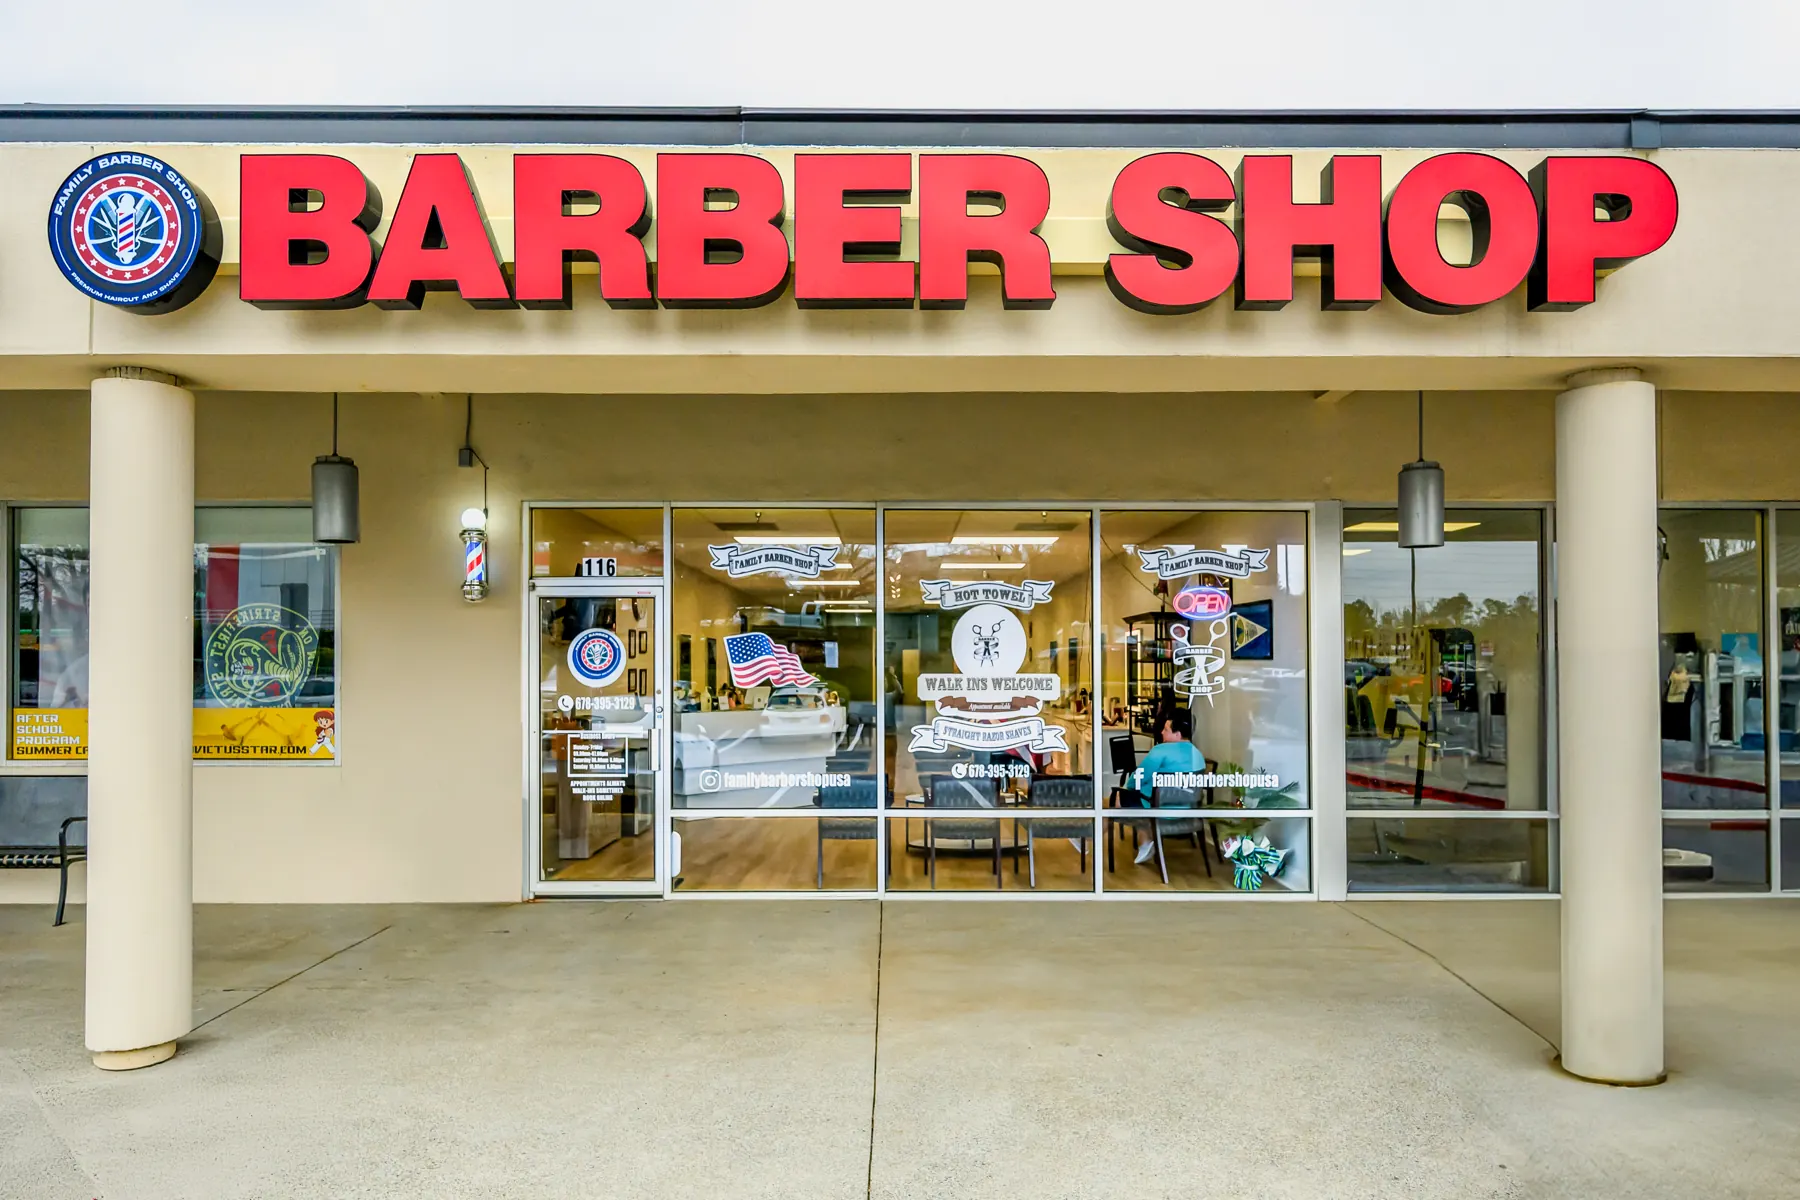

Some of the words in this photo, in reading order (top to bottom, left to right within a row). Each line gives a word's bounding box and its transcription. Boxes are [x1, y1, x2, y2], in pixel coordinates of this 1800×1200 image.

[54, 164, 93, 216] FAMILY
[98, 154, 164, 174] BARBER
[165, 170, 197, 211] SHOP
[240, 153, 1056, 309] BARBER
[1105, 152, 1678, 312] SHOP
[71, 271, 103, 298] PREMIUM
[104, 294, 139, 303] HAIRCUT
[142, 290, 158, 300] AND
[159, 272, 181, 292] SHAVE
[584, 558, 616, 576] 116
[734, 555, 763, 569] FAMILY
[764, 553, 793, 565] BARBER
[794, 558, 813, 569] SHOP
[1165, 558, 1192, 572] FAMILY
[1194, 557, 1223, 568] BARBER
[1225, 561, 1244, 572] SHOP
[954, 589, 979, 601] HOT
[982, 589, 1026, 602] TOWEL
[1173, 592, 1229, 614] OPEN
[925, 677, 963, 691] WALK
[967, 677, 988, 691] INS
[991, 677, 1053, 691] WELCOME
[575, 696, 635, 710] 678-395-3129
[16, 714, 58, 723] AFTER
[16, 725, 65, 734] SCHOOL
[942, 725, 981, 741] STRAIGHT
[982, 731, 1004, 742] RAZOR
[1005, 726, 1032, 739] SHAVES
[16, 736, 80, 745] PROGRAM
[17, 746, 72, 755] SUMMER
[75, 746, 89, 755] CA
[193, 745, 307, 755] VICTUSSTAR.COM
[968, 764, 1030, 778] 678-395-3129
[723, 771, 851, 789] familybarbershopusa
[1152, 771, 1279, 789] familybarbershopusa
